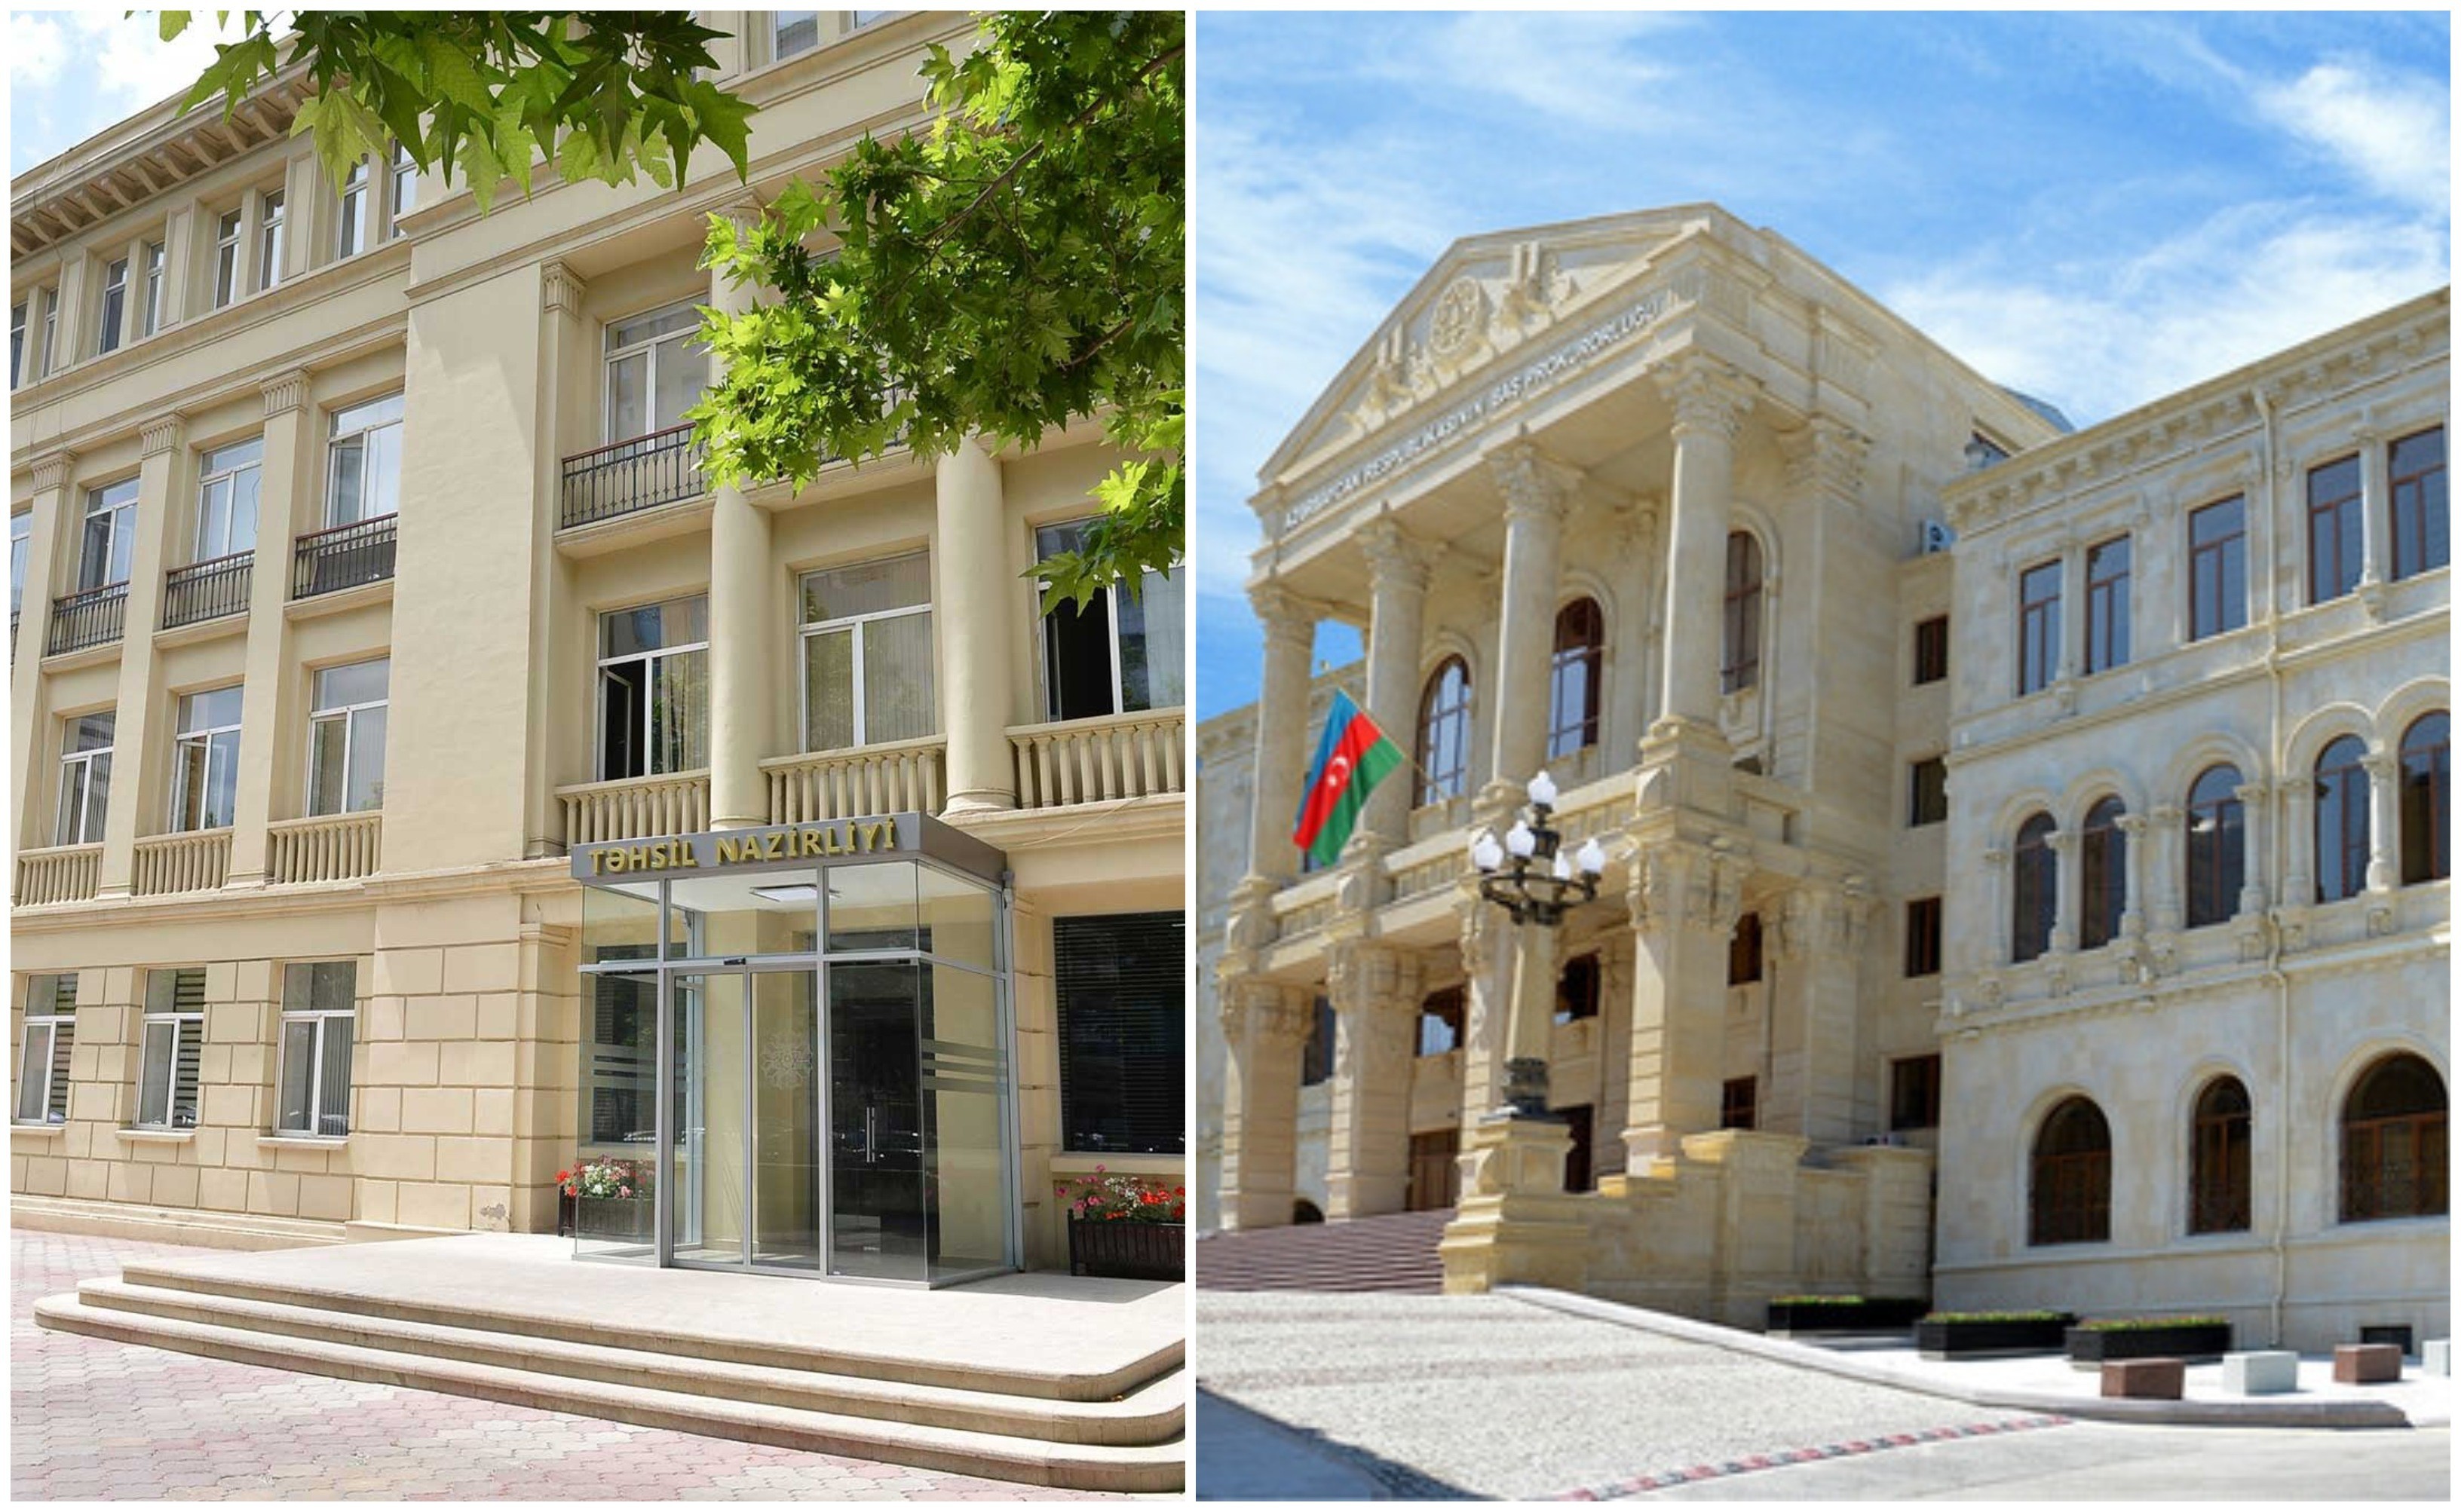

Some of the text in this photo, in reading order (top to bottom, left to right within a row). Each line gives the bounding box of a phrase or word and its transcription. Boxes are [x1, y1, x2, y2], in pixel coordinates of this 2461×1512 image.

[1286, 470, 1360, 528] AZCAN
[588, 816, 896, 876] TƏHSİL NAZİRLİYİ
